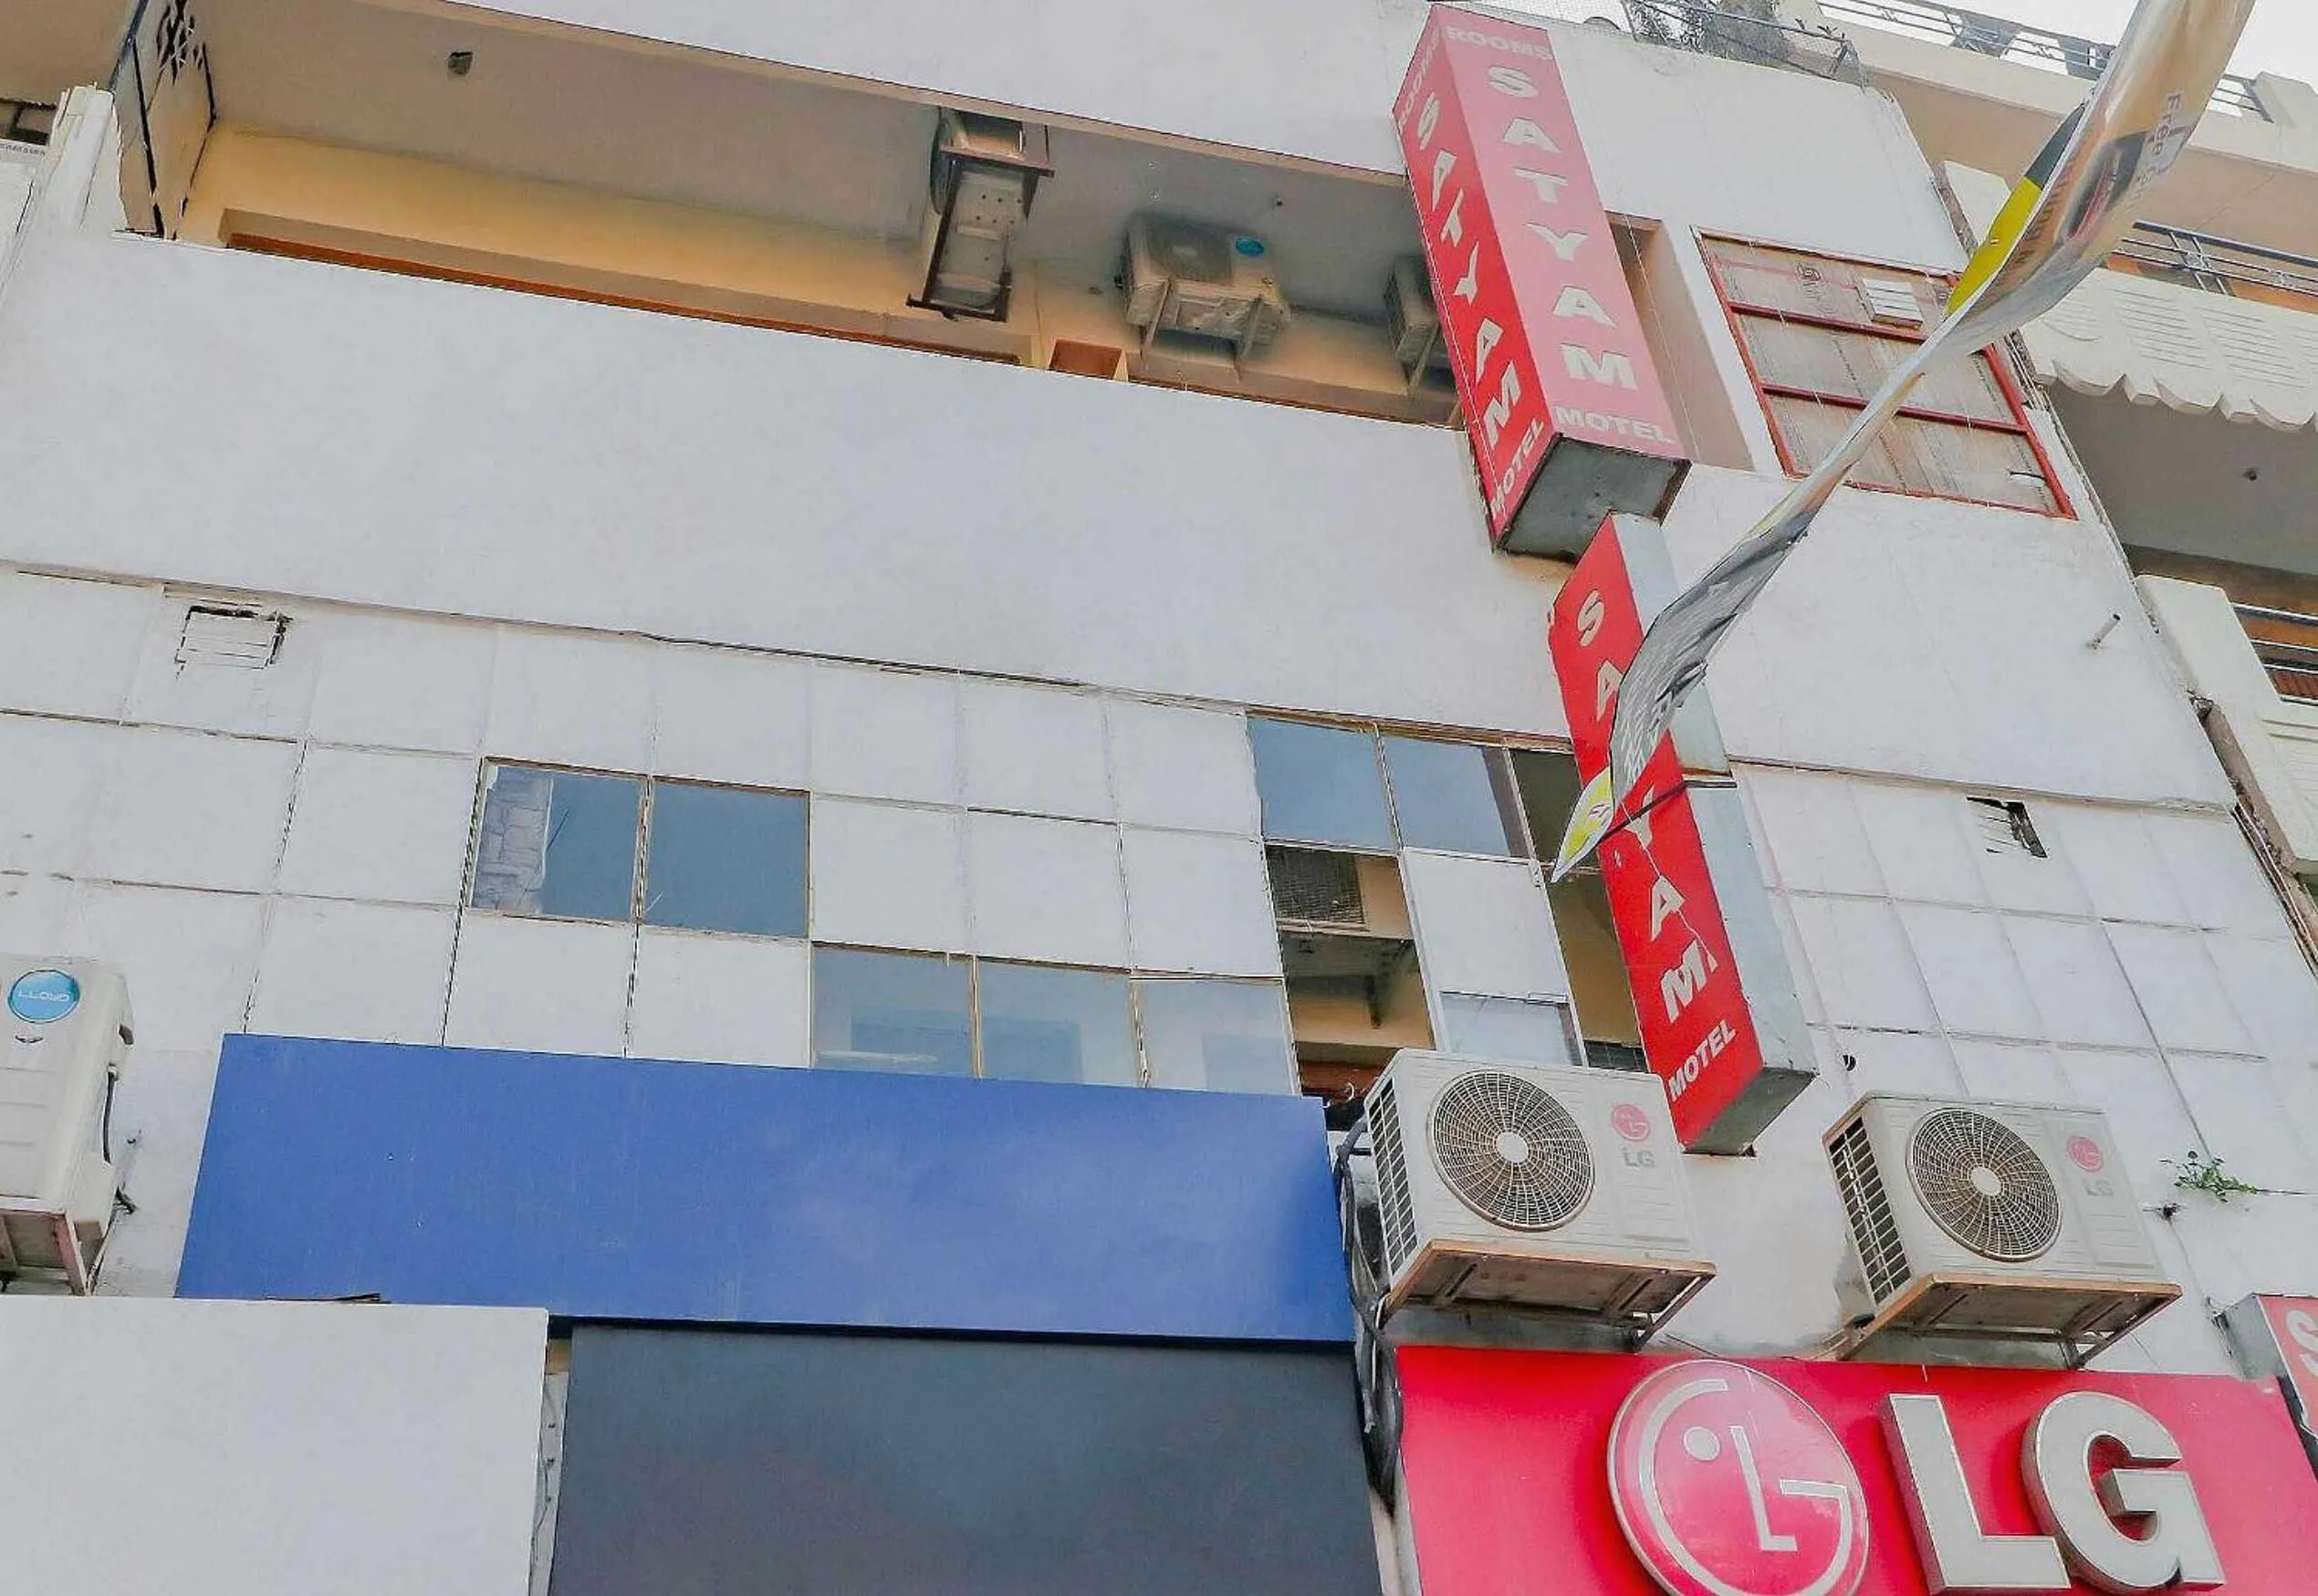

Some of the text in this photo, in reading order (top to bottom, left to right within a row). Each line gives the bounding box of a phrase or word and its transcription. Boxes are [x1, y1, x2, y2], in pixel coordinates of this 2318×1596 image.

[1444, 26, 1554, 60] ROOMS
[1417, 91, 1522, 450] SATYAM
[1487, 65, 1640, 391] SATYAM
[1490, 418, 1544, 520] MOTEL
[1554, 406, 1677, 444] MOTEL
[1576, 589, 1718, 1024] SAYAM
[1667, 1019, 1736, 1101] MOTEL
[1623, 1147, 1656, 1167] LG
[1880, 1391, 2225, 1594] LG
